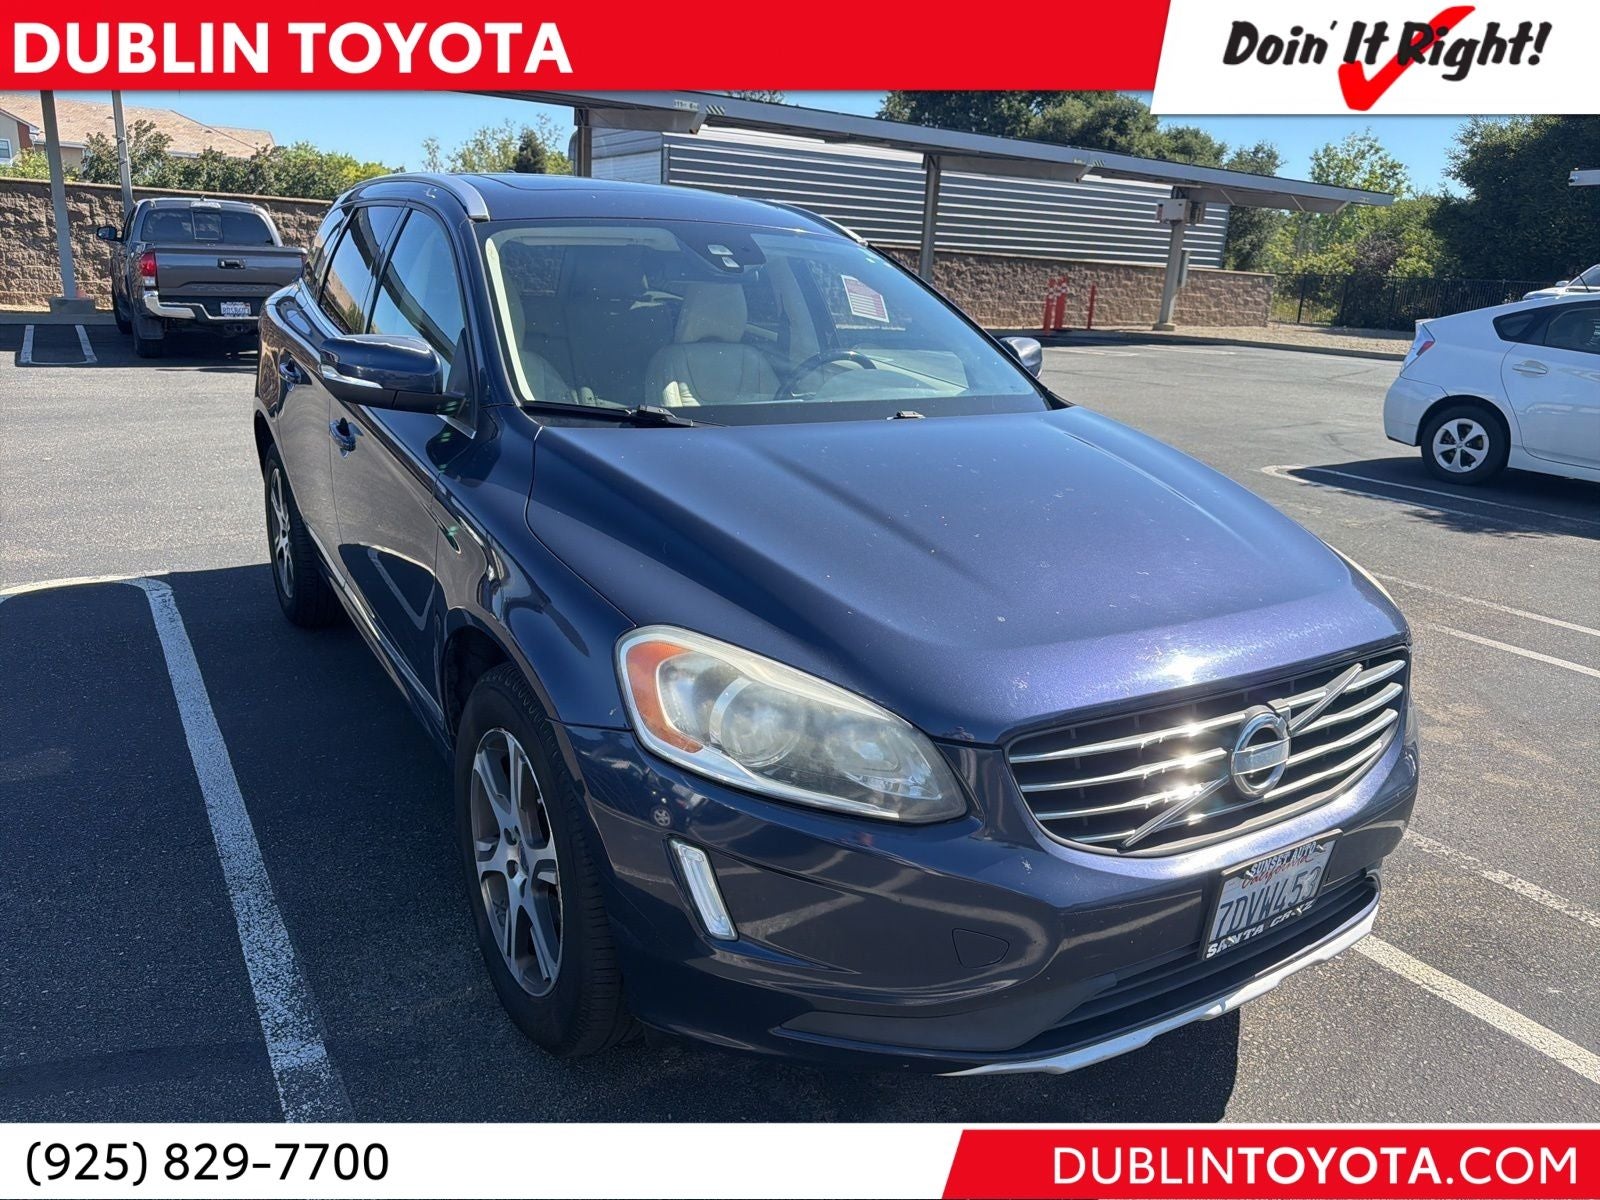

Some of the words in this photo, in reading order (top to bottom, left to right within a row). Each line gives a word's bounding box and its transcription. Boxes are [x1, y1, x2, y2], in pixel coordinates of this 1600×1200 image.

[1250, 851, 1292, 876] SUNSET
[1291, 841, 1317, 861] AUTO
[1214, 865, 1323, 939] 7DVW453
